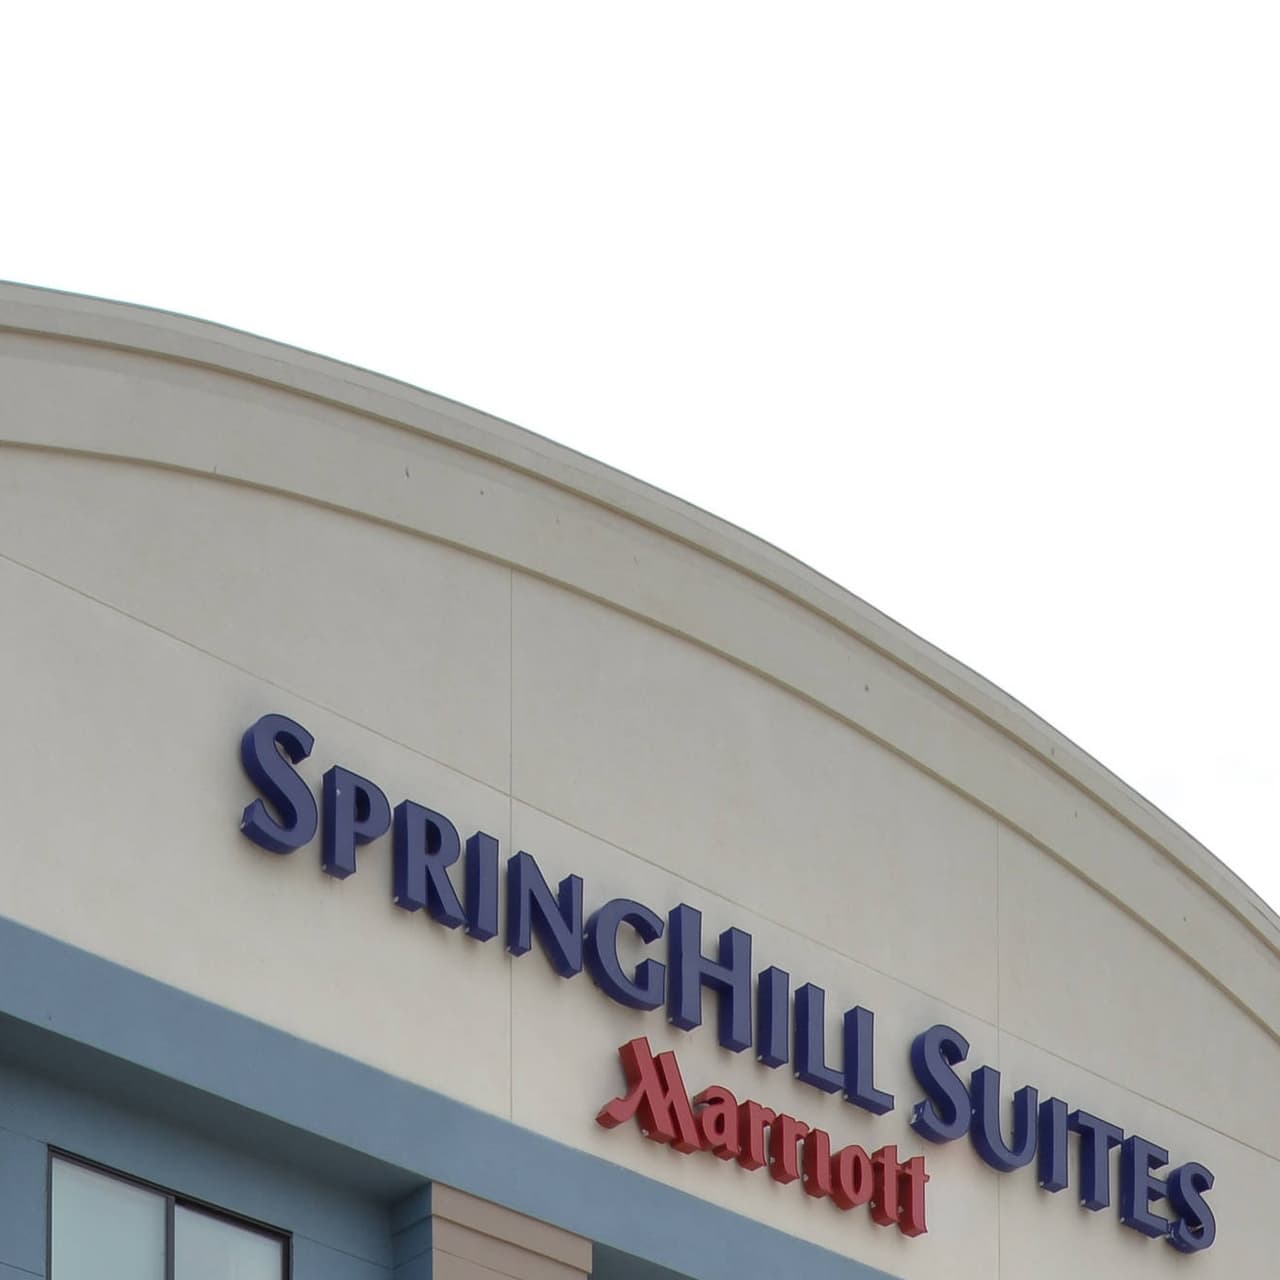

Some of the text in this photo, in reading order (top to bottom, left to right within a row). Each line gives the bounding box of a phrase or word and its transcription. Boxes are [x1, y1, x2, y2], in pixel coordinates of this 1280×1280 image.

[240, 713, 1217, 1255] SPRINGHILL SUITES
[595, 1037, 930, 1238] Marriott
